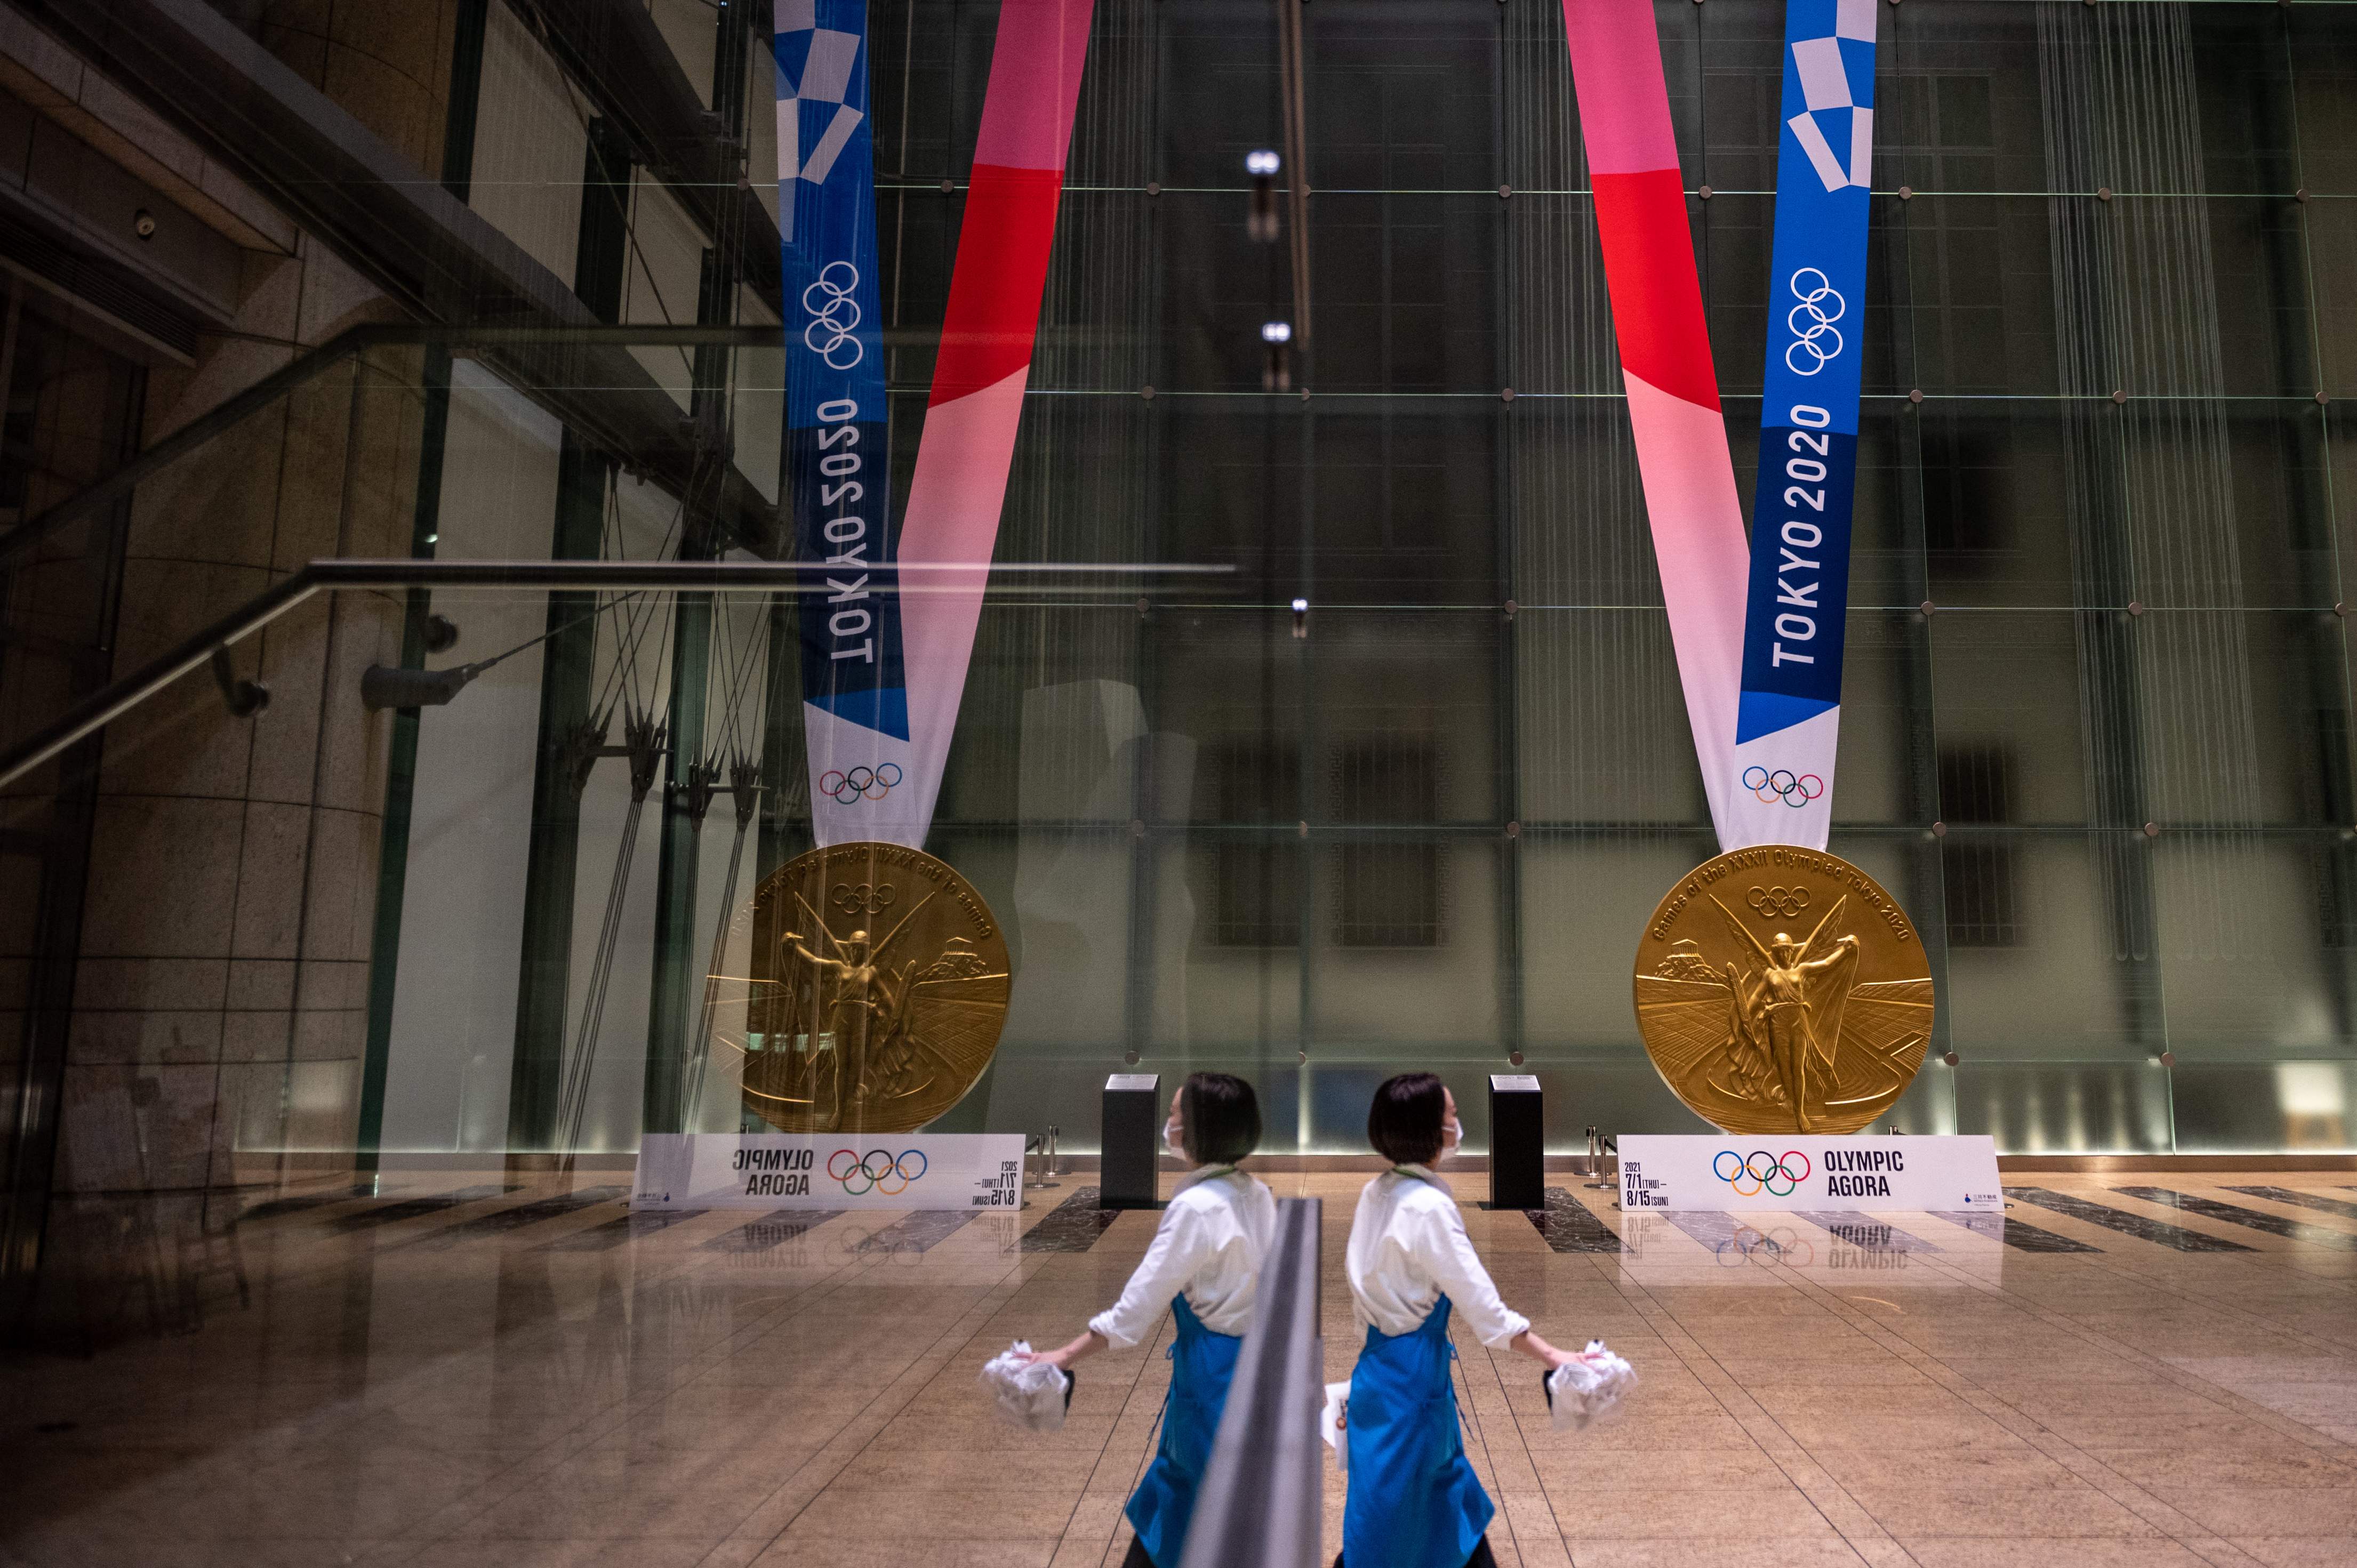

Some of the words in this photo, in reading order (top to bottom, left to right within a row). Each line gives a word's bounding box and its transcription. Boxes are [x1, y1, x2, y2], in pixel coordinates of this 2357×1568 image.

[1784, 405, 1831, 511] 2020
[1772, 521, 1823, 668] TOKYO
[1653, 894, 1688, 940] Games
[1687, 877, 1703, 897] of
[1702, 864, 1728, 884] the
[1728, 849, 1768, 872] XXXII
[1773, 849, 1845, 879] Olympiad
[1847, 870, 1882, 906] Tokyo
[1880, 904, 1910, 940] 2020
[1624, 1162, 1641, 1172] 2021
[1824, 1151, 1904, 1171] OLYMPIC
[1828, 1176, 1891, 1196] AGORA
